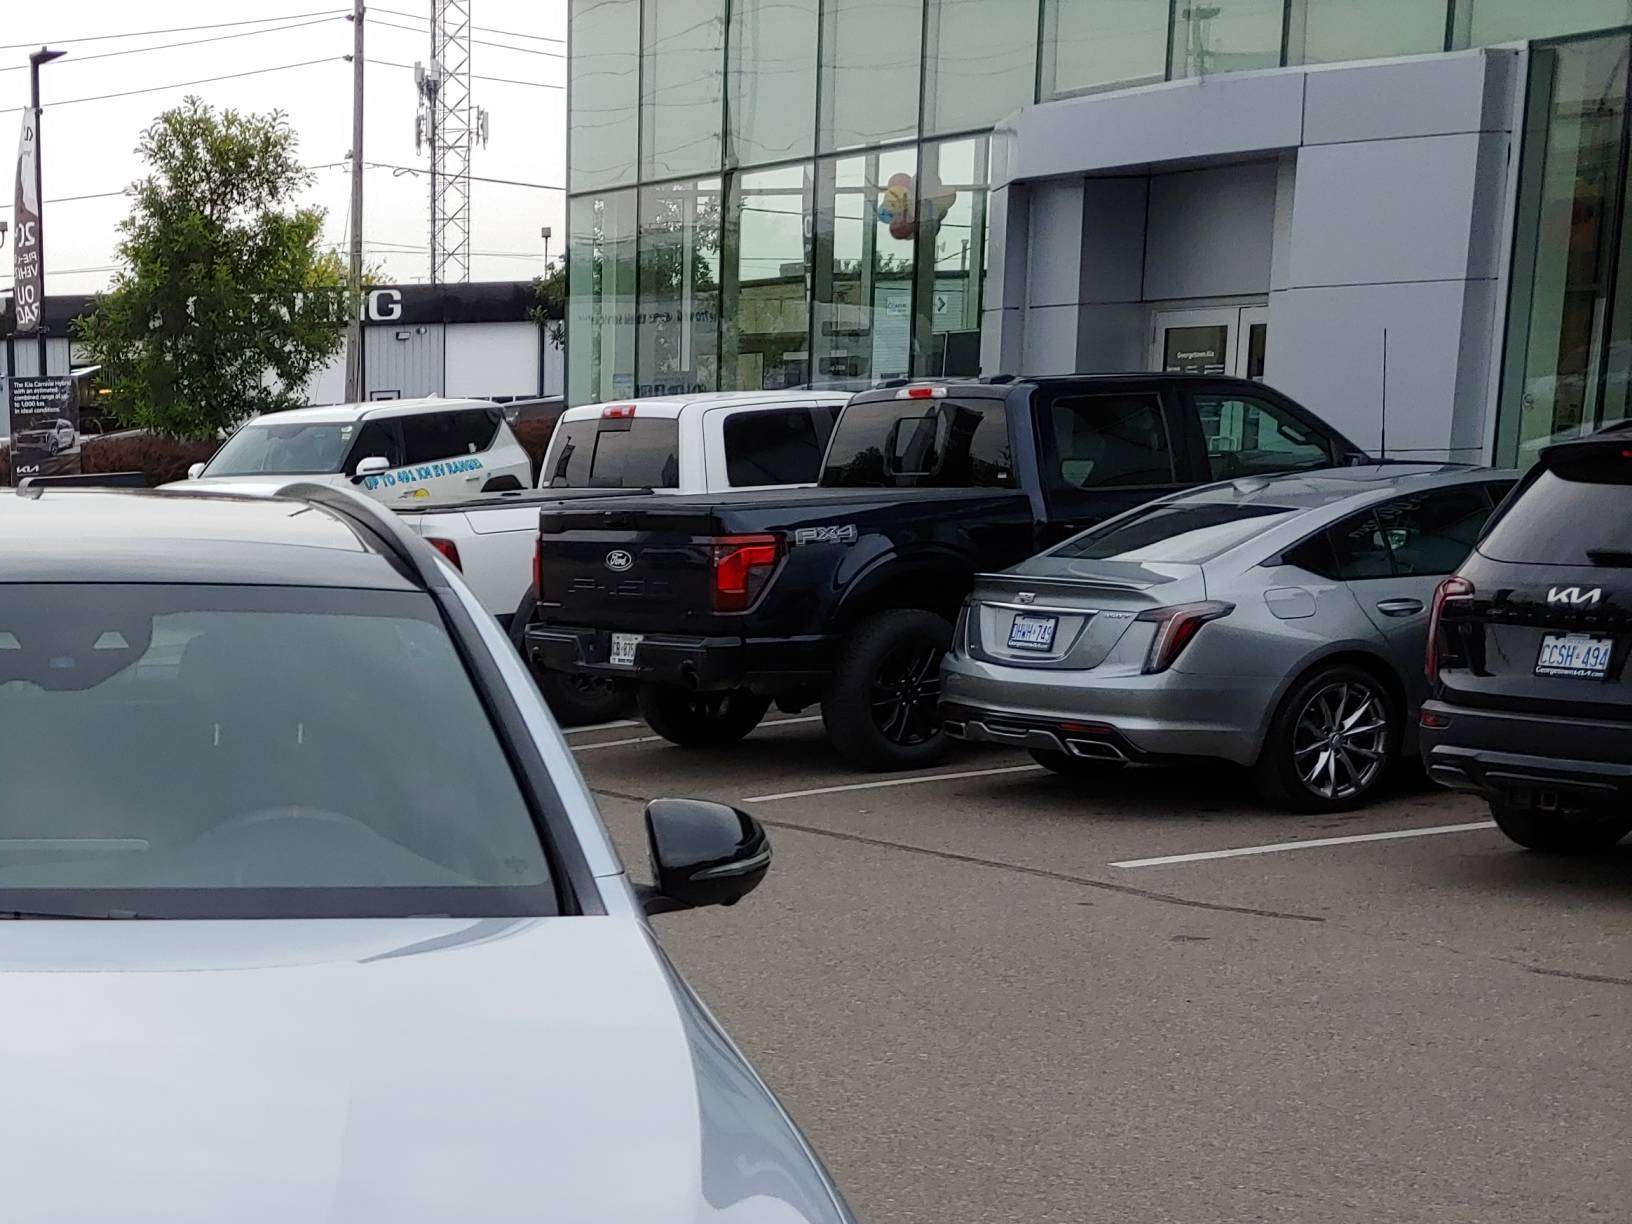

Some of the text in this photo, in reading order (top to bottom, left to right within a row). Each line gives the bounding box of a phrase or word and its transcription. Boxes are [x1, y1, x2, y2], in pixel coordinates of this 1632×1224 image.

[16, 465, 40, 473] KIA
[795, 524, 858, 544] FX4
[1547, 586, 1602, 604] KIA
